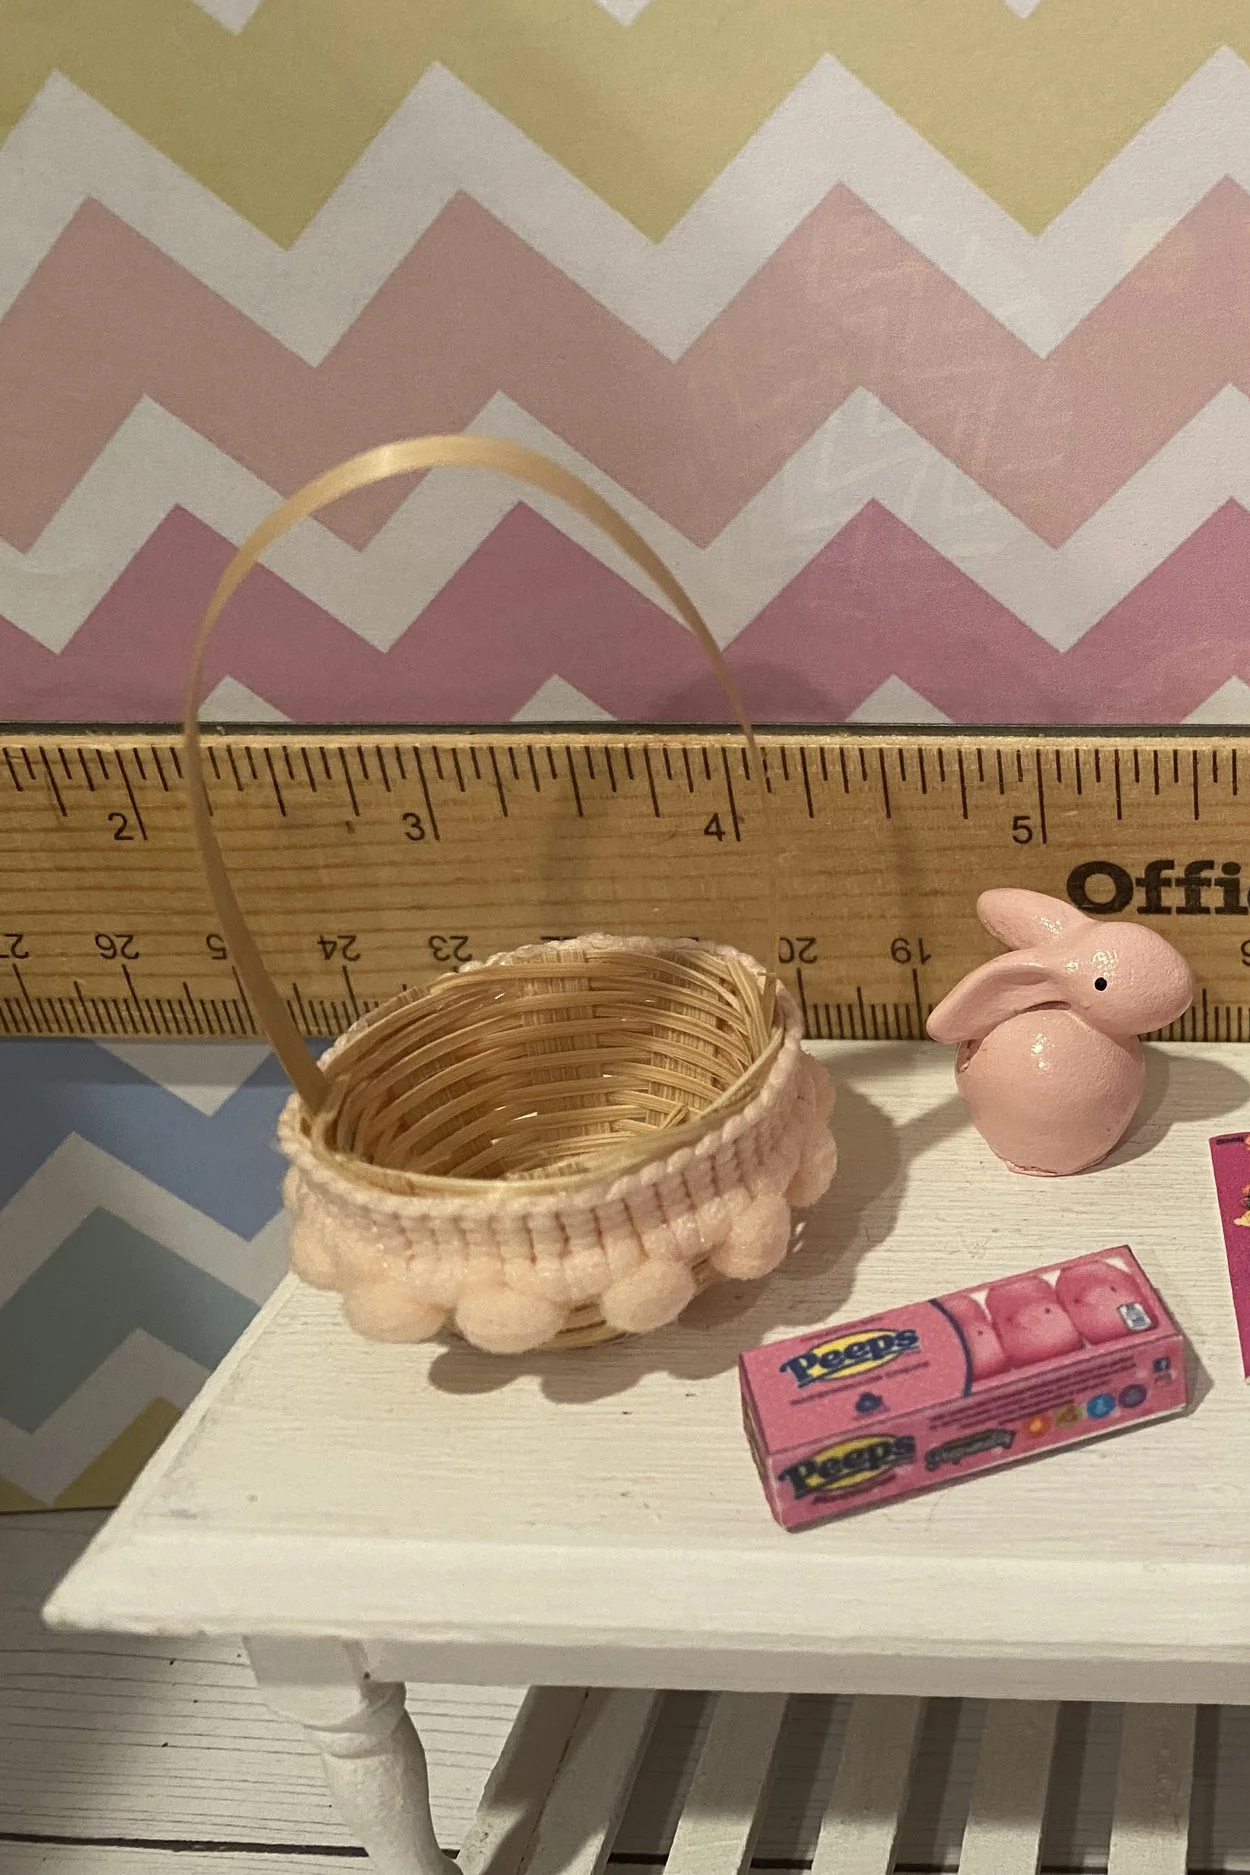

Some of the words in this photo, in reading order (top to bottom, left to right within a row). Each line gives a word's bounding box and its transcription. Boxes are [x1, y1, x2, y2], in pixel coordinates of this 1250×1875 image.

[107, 812, 135, 842] 2
[402, 812, 426, 842] 3
[703, 812, 726, 842] 4
[1011, 815, 1034, 845] 5
[94, 933, 140, 960] 26
[317, 935, 362, 962] 24
[428, 935, 473, 962] 23
[778, 936, 819, 964] 20
[890, 936, 932, 966] 19
[779, 1329, 920, 1388] Peeps
[778, 1435, 916, 1500] Peeps
